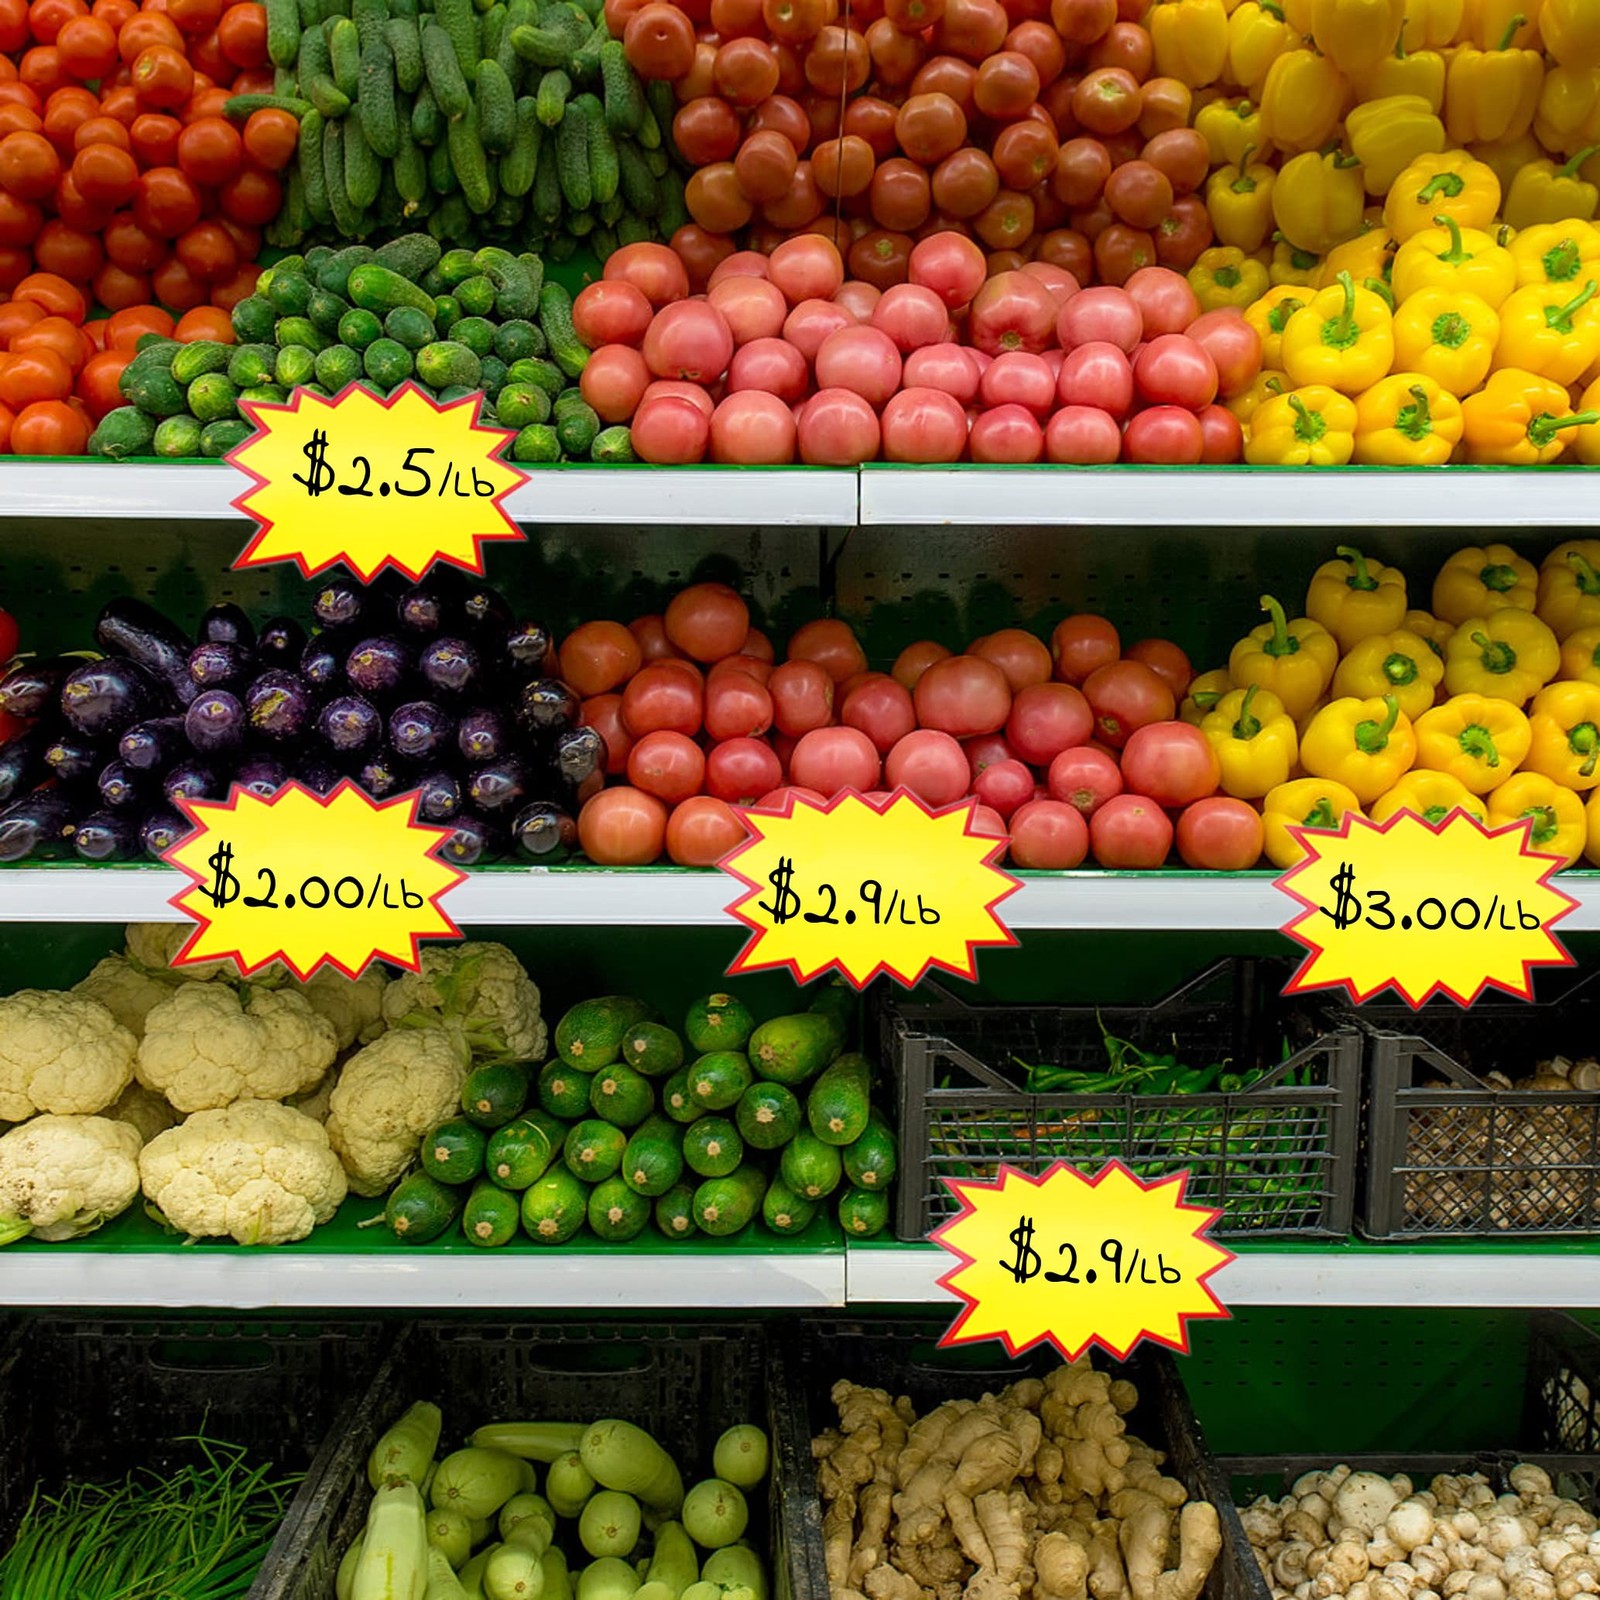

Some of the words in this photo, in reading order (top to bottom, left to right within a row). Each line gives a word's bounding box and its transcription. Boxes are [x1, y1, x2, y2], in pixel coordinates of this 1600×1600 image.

[293, 429, 494, 496] $2.5/Lb
[198, 841, 423, 908] $2.00/Lb
[759, 857, 938, 924] $2.9/Lb
[1320, 862, 1540, 930] $3.00/Lb
[999, 1216, 1180, 1283] $2.9/Lb
